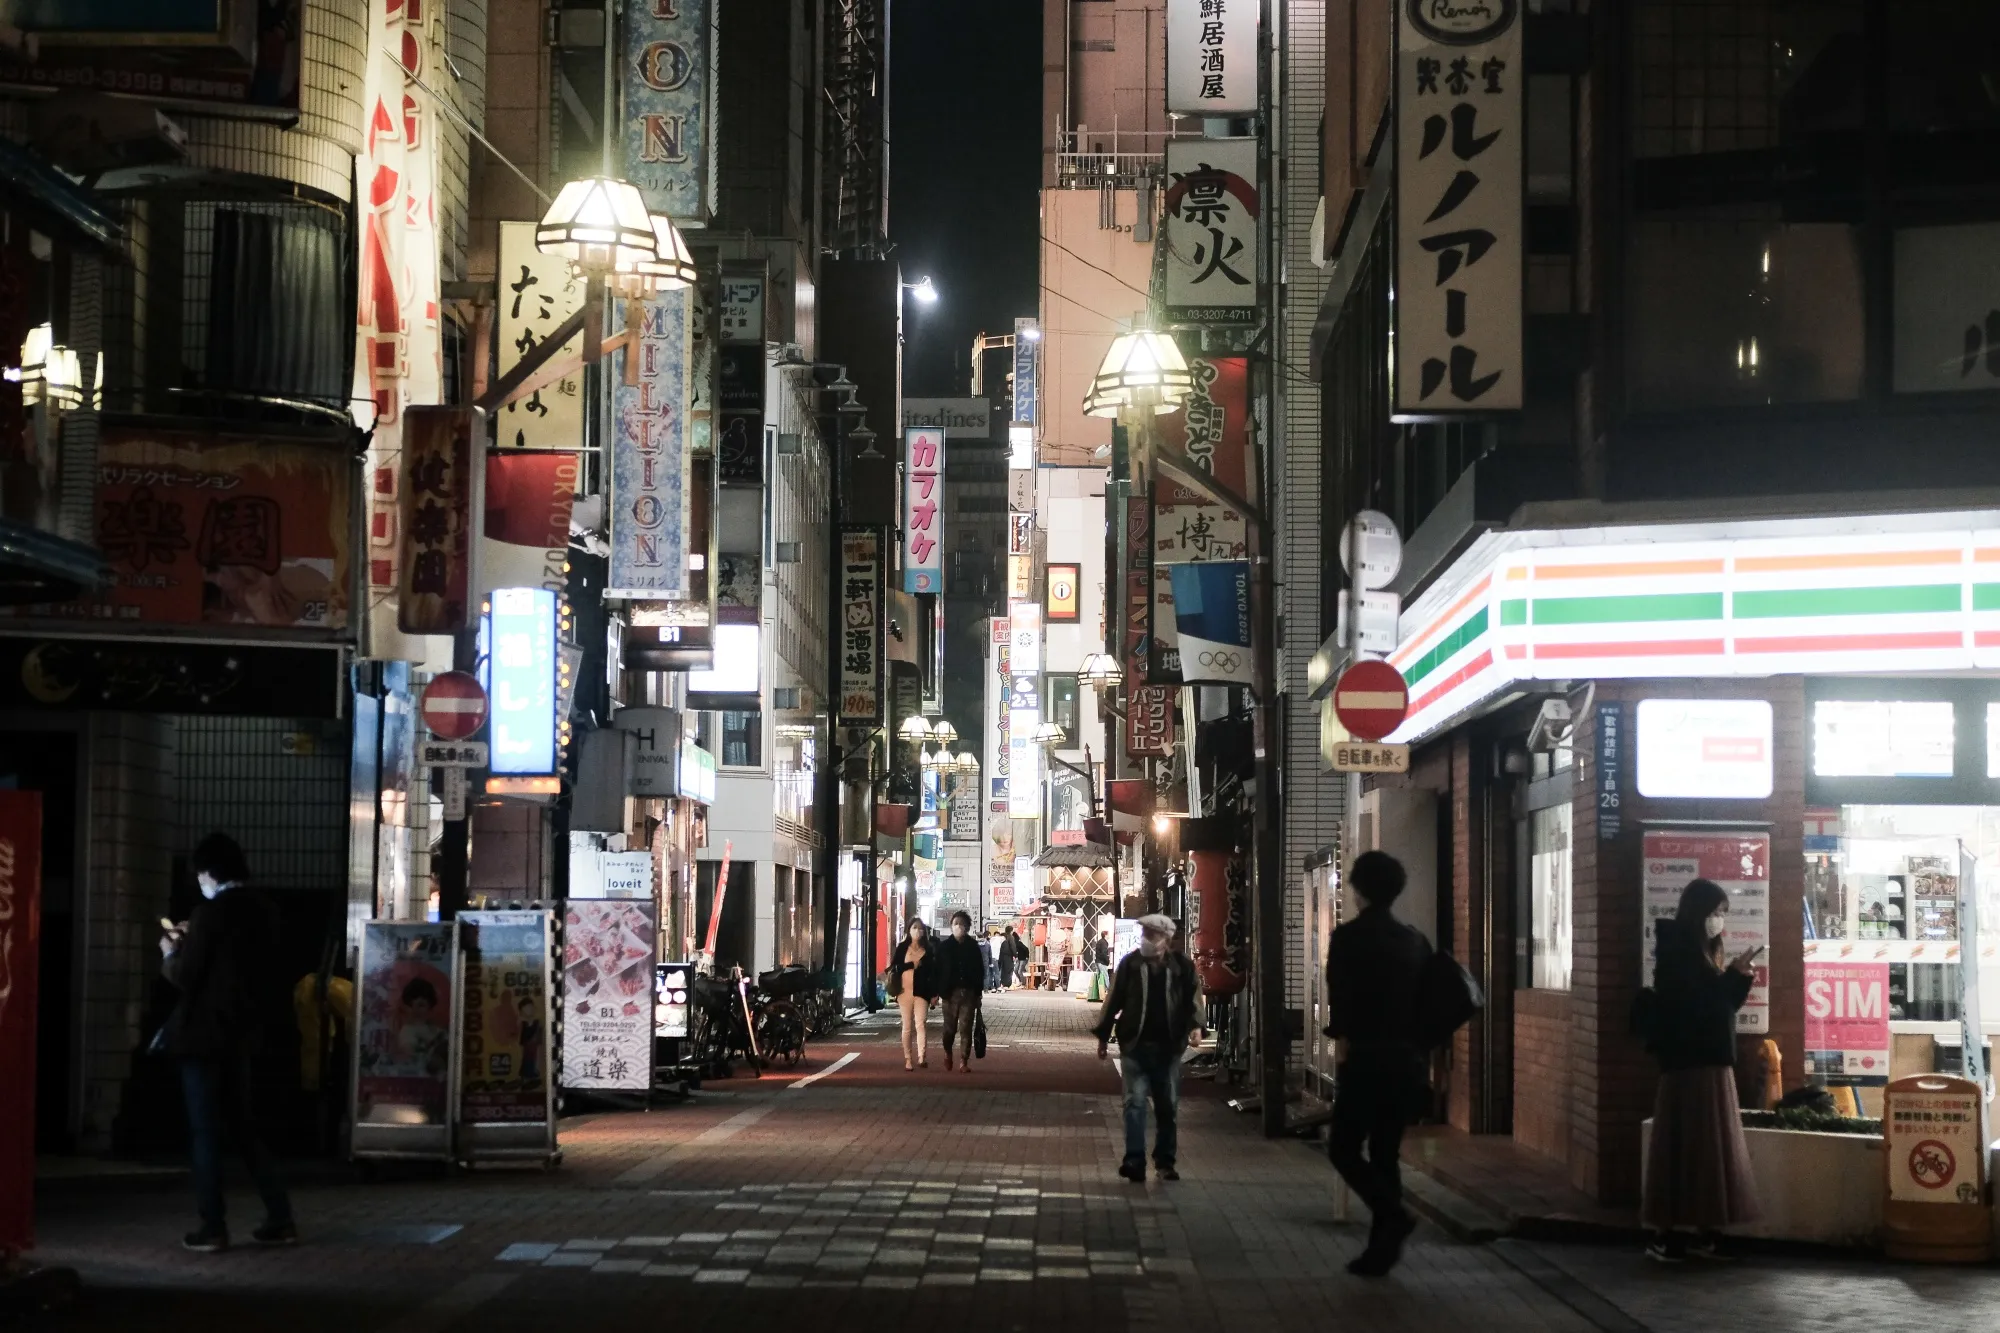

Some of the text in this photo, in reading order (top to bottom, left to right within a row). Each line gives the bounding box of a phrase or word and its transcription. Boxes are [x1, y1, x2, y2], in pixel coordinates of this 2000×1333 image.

[1417, 55, 1506, 95] 喫茶室
[1418, 102, 1504, 402] ルノアール
[630, 305, 669, 567] MILLION
[548, 453, 578, 532] TOKYO
[910, 436, 938, 566] カラオケ
[625, 576, 665, 588] ミリオン
[305, 602, 326, 620] 2F
[1235, 573, 1249, 644] TOKYO 2020
[844, 564, 875, 676] 一軒め酒場
[659, 626, 681, 642] B1
[842, 695, 875, 714] 190円
[1338, 748, 1402, 767] 自転車を除く
[1601, 792, 1620, 808] 26
[630, 866, 644, 874] Bar
[608, 877, 643, 889] loveit
[1807, 969, 1845, 978] PREPAID
[1806, 980, 1882, 1019] SIM
[601, 1007, 615, 1018] B1
[582, 1059, 630, 1081] 道楽
